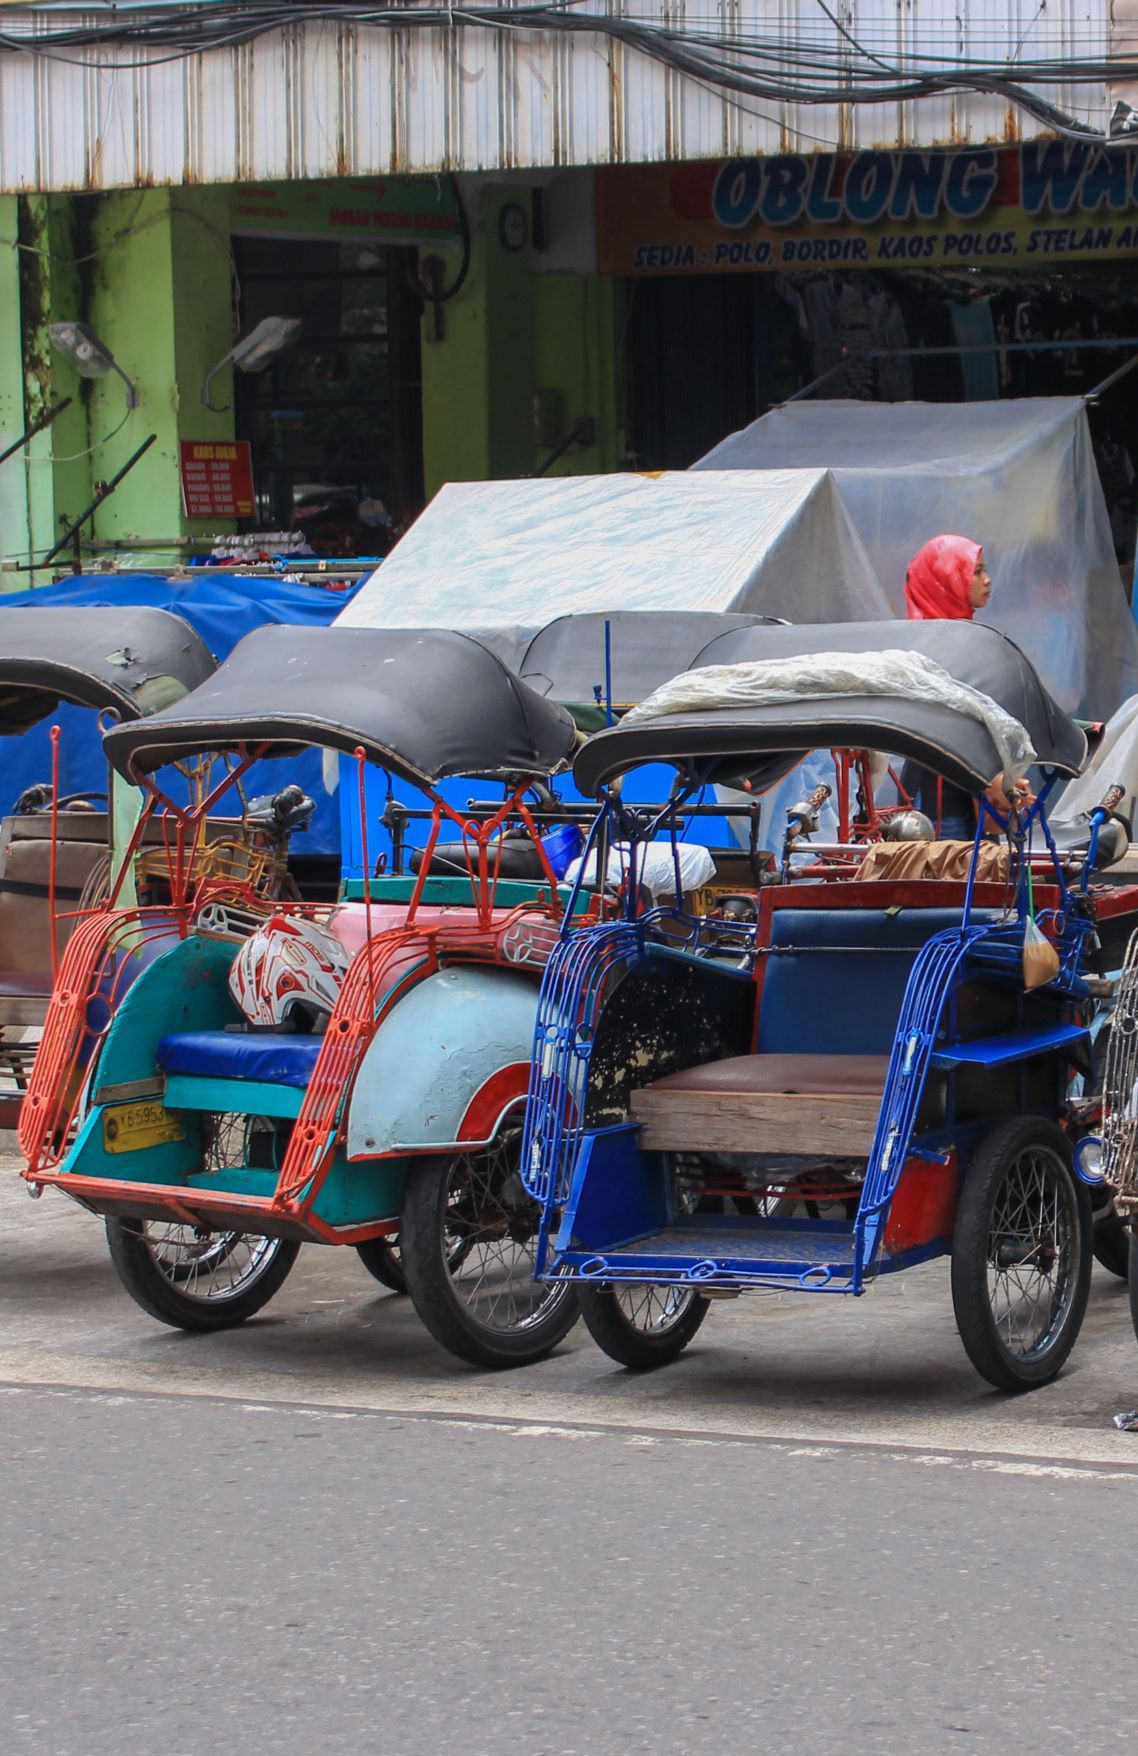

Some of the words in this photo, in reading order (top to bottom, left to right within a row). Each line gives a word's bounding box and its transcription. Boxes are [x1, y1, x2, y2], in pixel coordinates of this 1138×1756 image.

[712, 148, 998, 228] OBLONG
[634, 247, 696, 268] SEDIA
[715, 239, 774, 266] POLO,
[782, 236, 870, 262] BORDIR,
[877, 234, 939, 260] KAOS
[943, 230, 1018, 257] POLOS,
[1025, 226, 1112, 253] STELAN
[696, 889, 714, 906] YB
